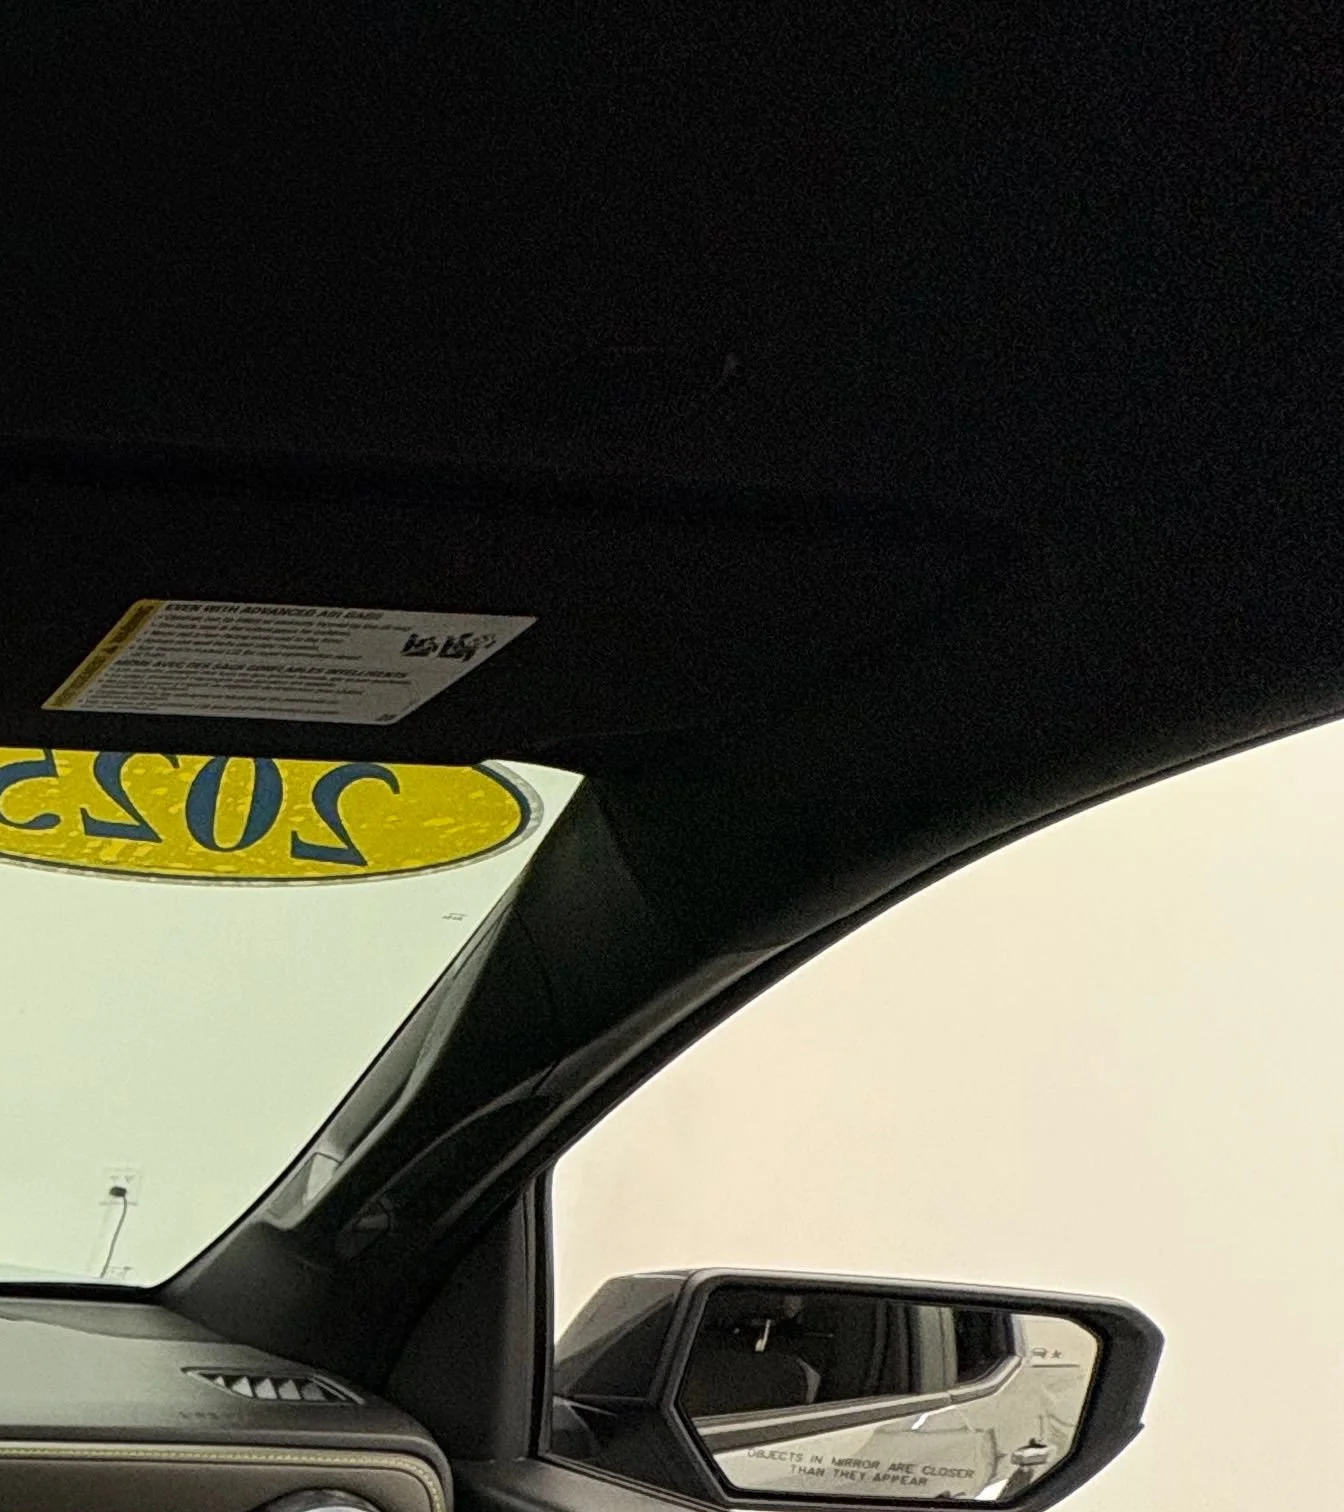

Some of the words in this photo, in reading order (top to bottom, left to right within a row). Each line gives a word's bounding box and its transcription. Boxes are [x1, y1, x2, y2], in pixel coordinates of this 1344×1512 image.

[747, 1449, 804, 1463] OBJECTS
[809, 1455, 824, 1465] IN
[831, 1456, 881, 1471] MIRROR
[888, 1462, 915, 1475] ARE
[921, 1465, 976, 1480] CLOSER
[790, 1464, 826, 1477] THAN
[833, 1468, 867, 1482] THEY
[871, 1472, 929, 1487] APPEAR
